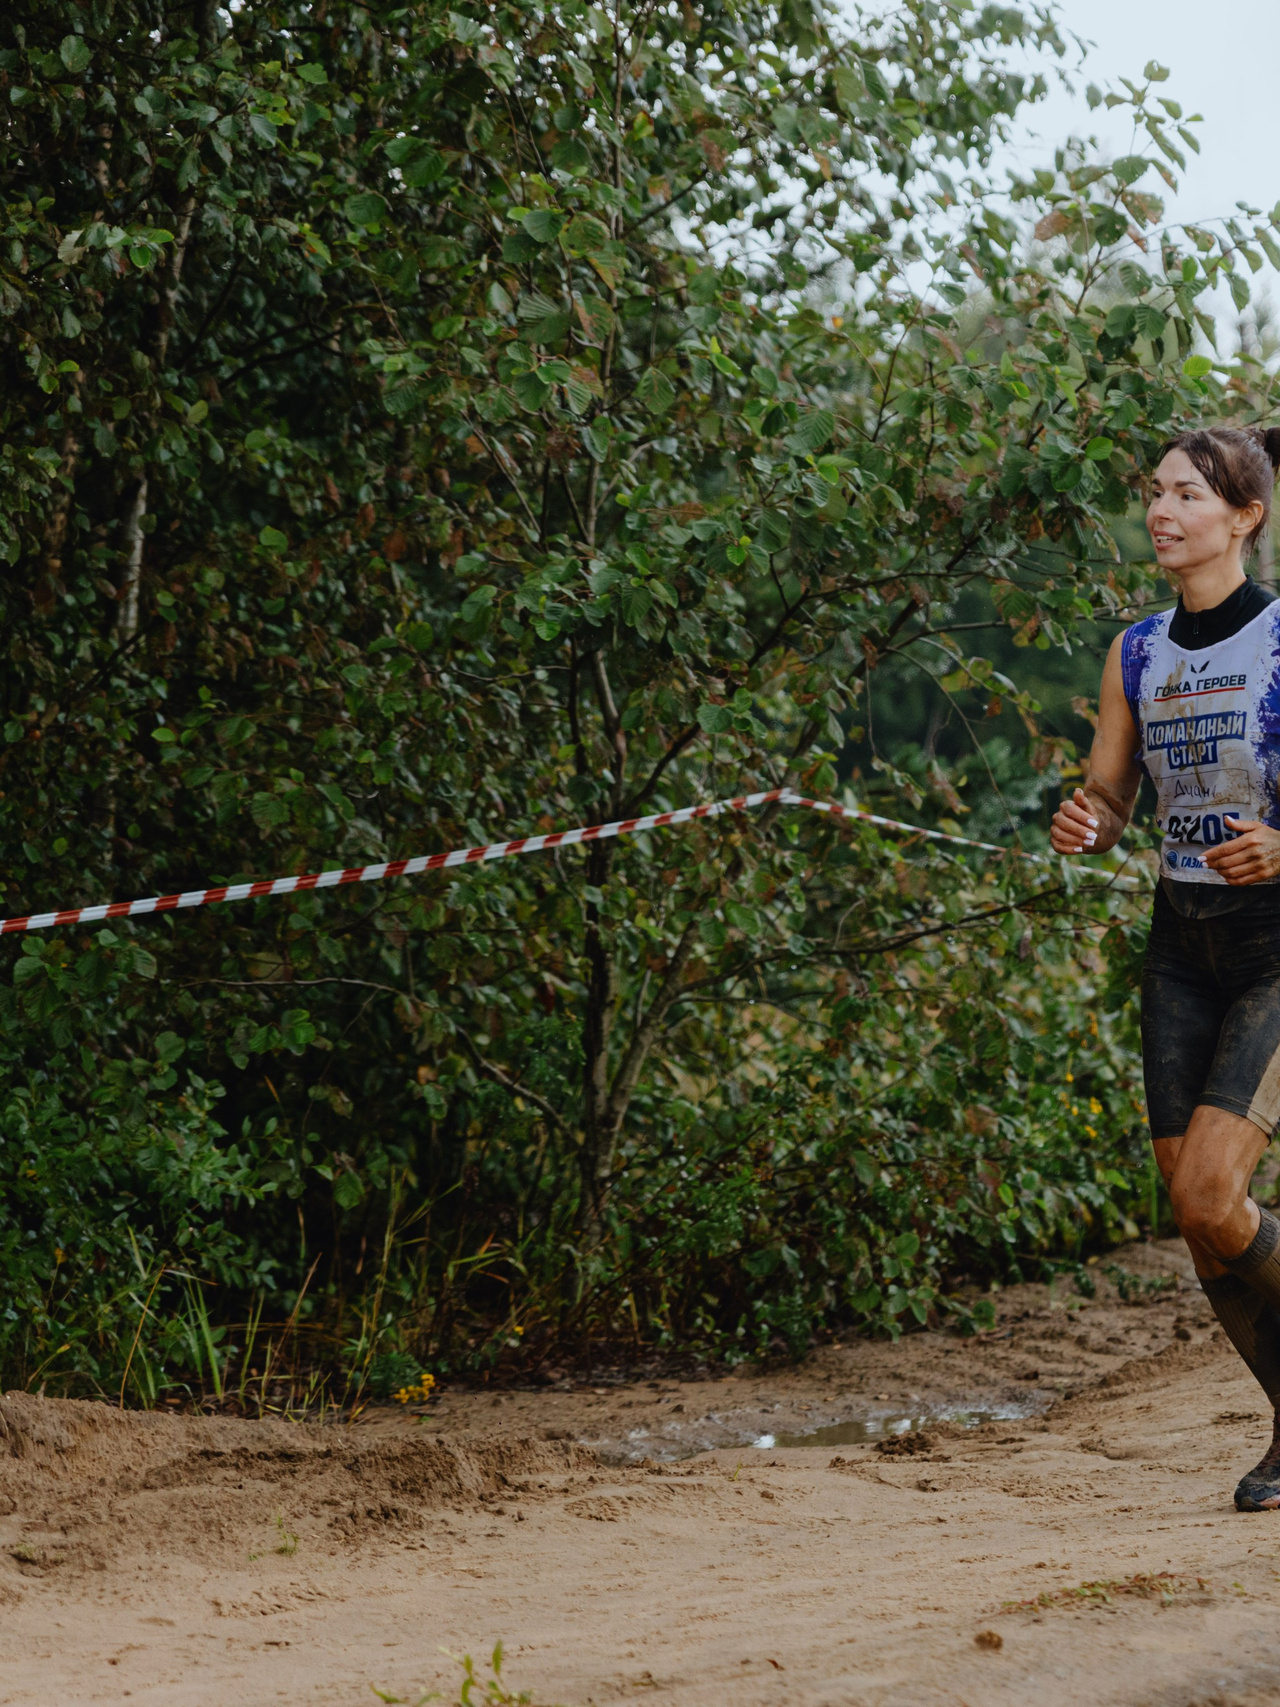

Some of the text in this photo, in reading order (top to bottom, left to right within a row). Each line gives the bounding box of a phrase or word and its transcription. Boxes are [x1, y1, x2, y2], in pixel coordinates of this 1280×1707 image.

[1155, 674, 1247, 698] ГОНКА ГЕРОЕВ
[1149, 711, 1245, 747] КОМАНДНЫЙ
[1170, 741, 1215, 767] СТАРТ
